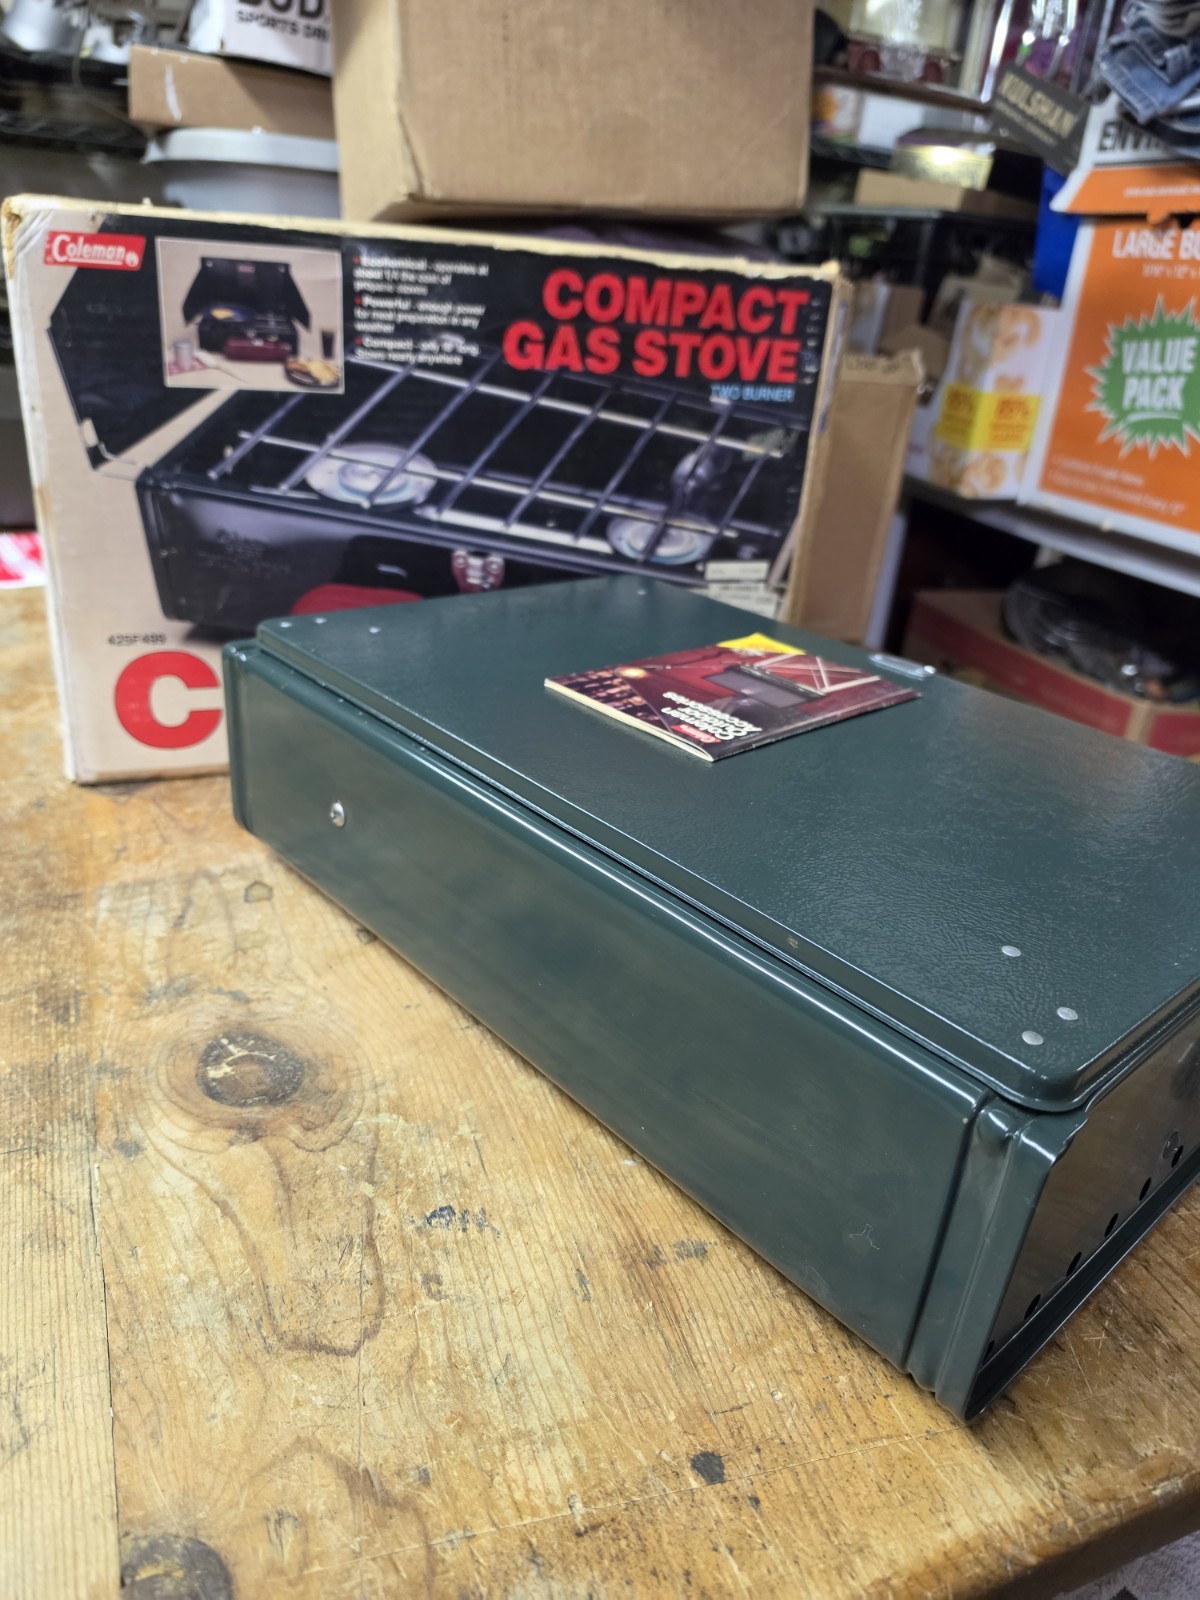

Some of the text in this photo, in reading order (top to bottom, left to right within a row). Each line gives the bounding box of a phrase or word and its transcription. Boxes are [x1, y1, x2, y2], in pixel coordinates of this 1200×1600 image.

[236, 10, 298, 35] SPORTS
[52, 234, 126, 263] Coleman
[1112, 229, 1176, 259] LARGE
[542, 268, 810, 335] COMPACT
[502, 319, 621, 375] GAS
[631, 328, 802, 383] STOVE
[1121, 336, 1199, 374] VALUE
[711, 383, 794, 402] TWO BURNER
[1121, 375, 1187, 411] PACK
[661, 707, 735, 740] Coleman
[662, 691, 763, 732] Accessories
[677, 706, 748, 736] Outdoor
